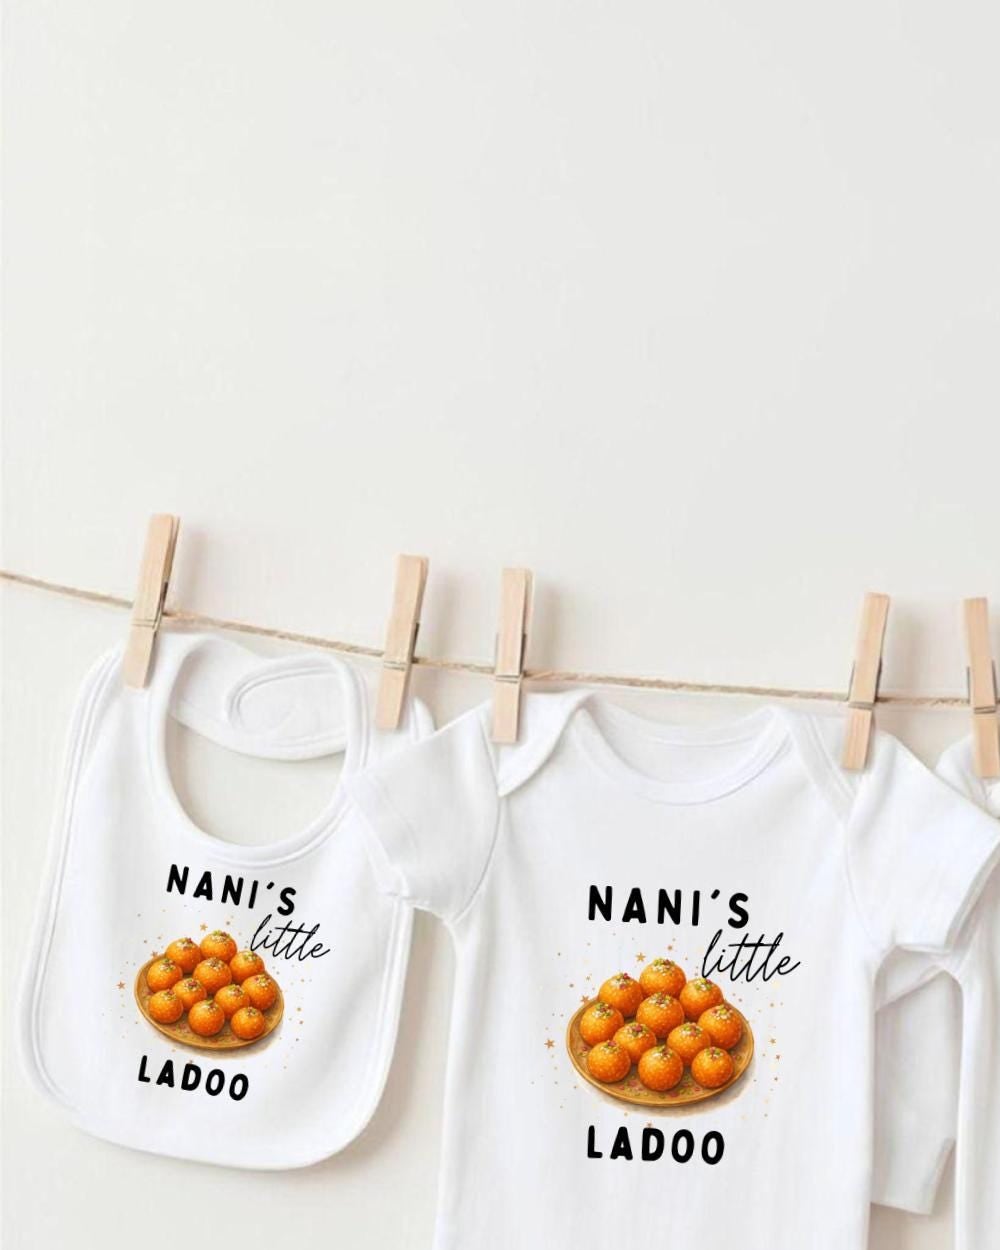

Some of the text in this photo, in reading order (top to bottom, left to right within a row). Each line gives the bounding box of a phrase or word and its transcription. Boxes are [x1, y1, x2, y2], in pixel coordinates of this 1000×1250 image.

[166, 863, 297, 917] NANI'S
[587, 884, 750, 930] NANI'S
[249, 913, 331, 962] little
[701, 928, 802, 983] little
[137, 1054, 250, 1102] LADOO
[586, 1124, 726, 1166] LADOO
